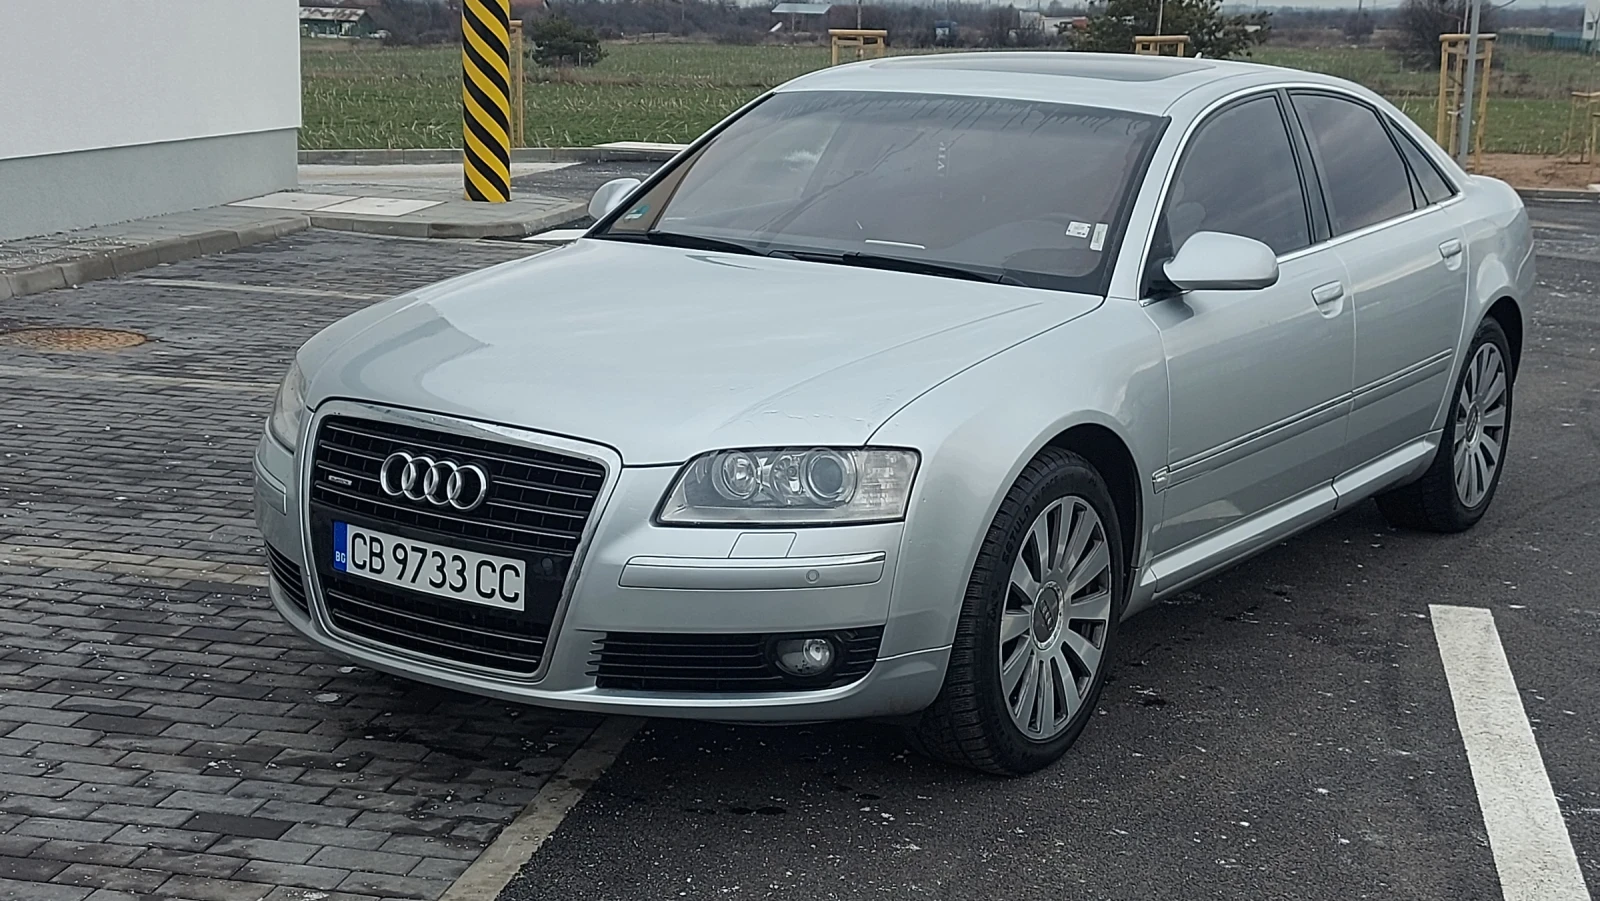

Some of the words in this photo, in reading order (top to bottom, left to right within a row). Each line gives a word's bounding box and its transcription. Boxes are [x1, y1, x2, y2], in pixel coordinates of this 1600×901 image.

[1001, 504, 1032, 564] SETULA
[335, 550, 346, 564] BG
[351, 532, 385, 575] CB
[392, 542, 468, 593] 9733
[475, 559, 521, 604] CC
